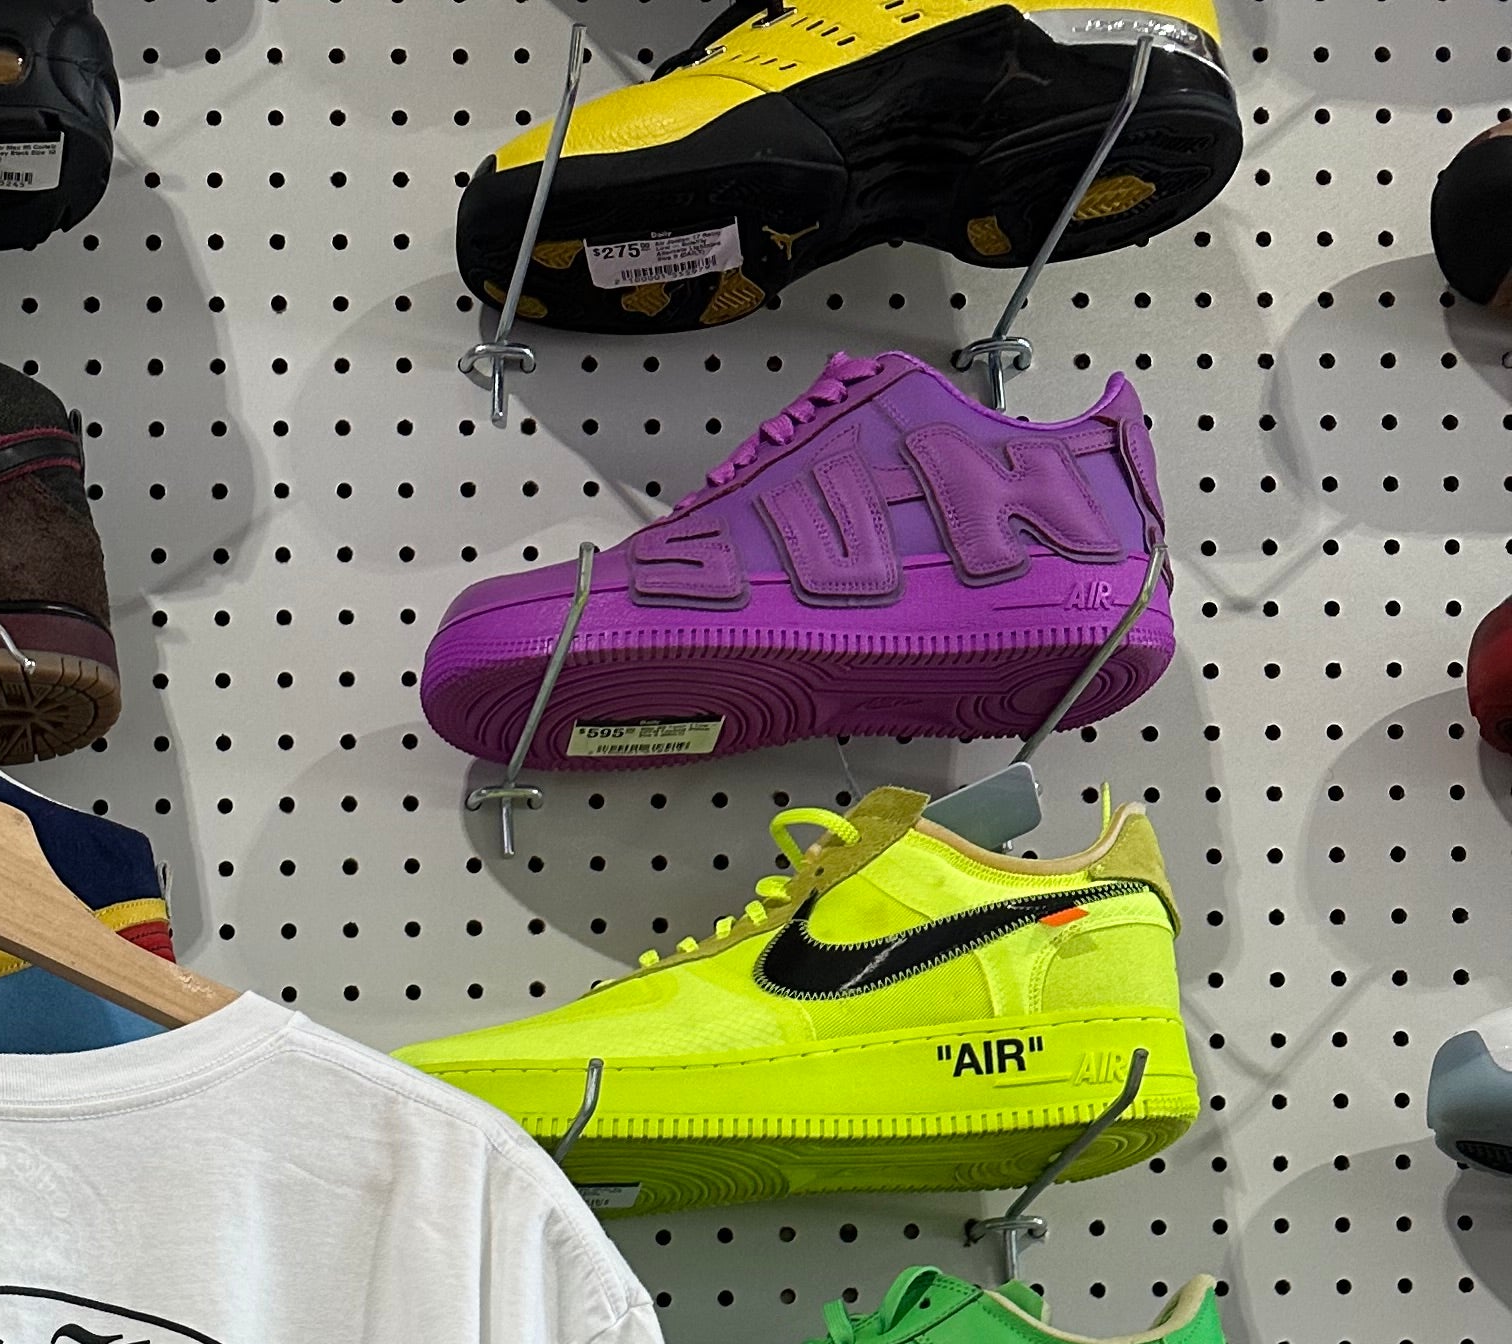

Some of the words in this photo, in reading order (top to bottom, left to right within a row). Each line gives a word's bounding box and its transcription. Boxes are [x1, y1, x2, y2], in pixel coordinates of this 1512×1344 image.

[592, 243, 641, 260] $275
[1064, 581, 1114, 611] AIR
[579, 727, 625, 739] $595
[937, 1036, 1043, 1077] "AIR"
